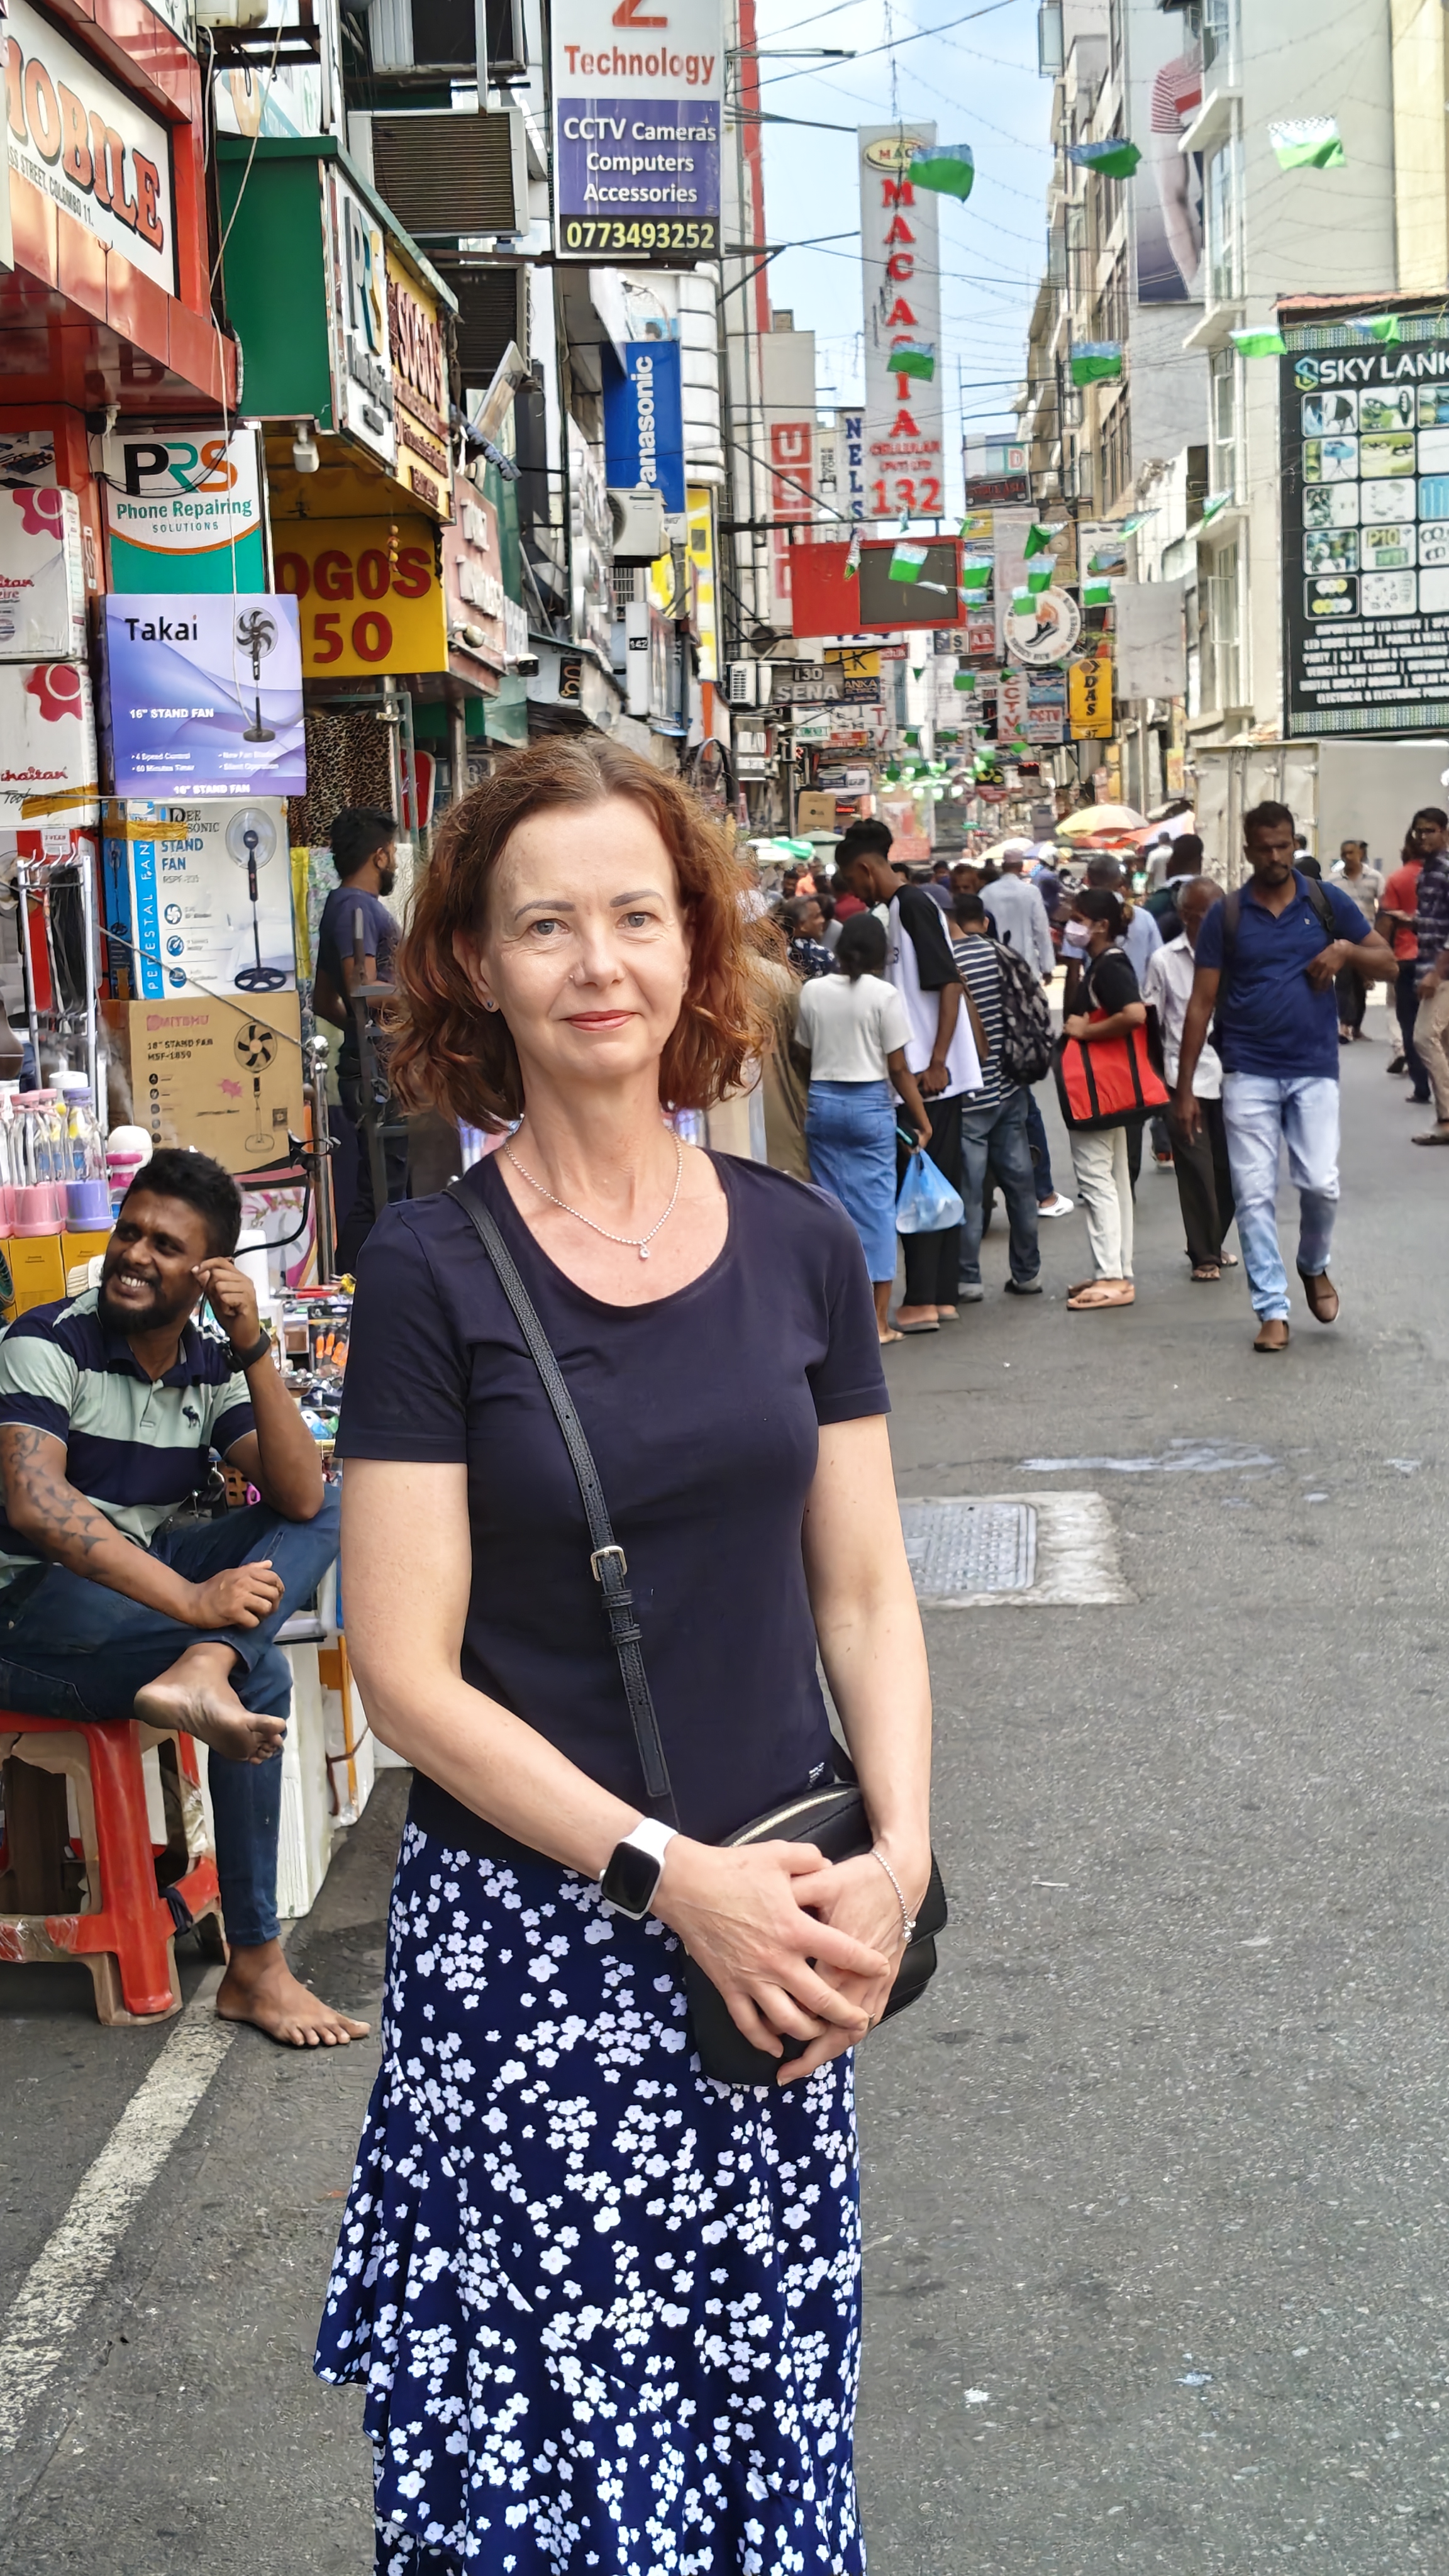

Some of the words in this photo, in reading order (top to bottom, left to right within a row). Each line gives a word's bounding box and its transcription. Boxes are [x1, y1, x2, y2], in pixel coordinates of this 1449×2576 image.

[564, 45, 714, 85] Technology
[564, 118, 626, 140] CCTV
[632, 122, 717, 142] Cameras
[587, 152, 694, 175] Computers
[584, 182, 698, 203] Accessories
[567, 221, 716, 248] 0773493252
[881, 178, 921, 438] MACAIA
[1320, 356, 1376, 384] SKY
[124, 440, 238, 495] PRS
[870, 477, 942, 514] 132
[117, 503, 168, 519] Phone
[172, 499, 252, 517] Repairing
[152, 521, 219, 533] SOLUTIONS
[125, 614, 198, 641] Takai
[314, 611, 392, 663] 50
[777, 684, 840, 702] SENA
[150, 708, 189, 718] STAND
[191, 708, 214, 718] FAN
[192, 785, 228, 794] STAND
[230, 784, 251, 793] FAN
[161, 838, 204, 852] STAND
[139, 844, 153, 880] FAN
[162, 857, 187, 871] FAN
[143, 894, 159, 991] PEDESTAL
[164, 1040, 194, 1049] STAND
[196, 1038, 213, 1047] FAN
